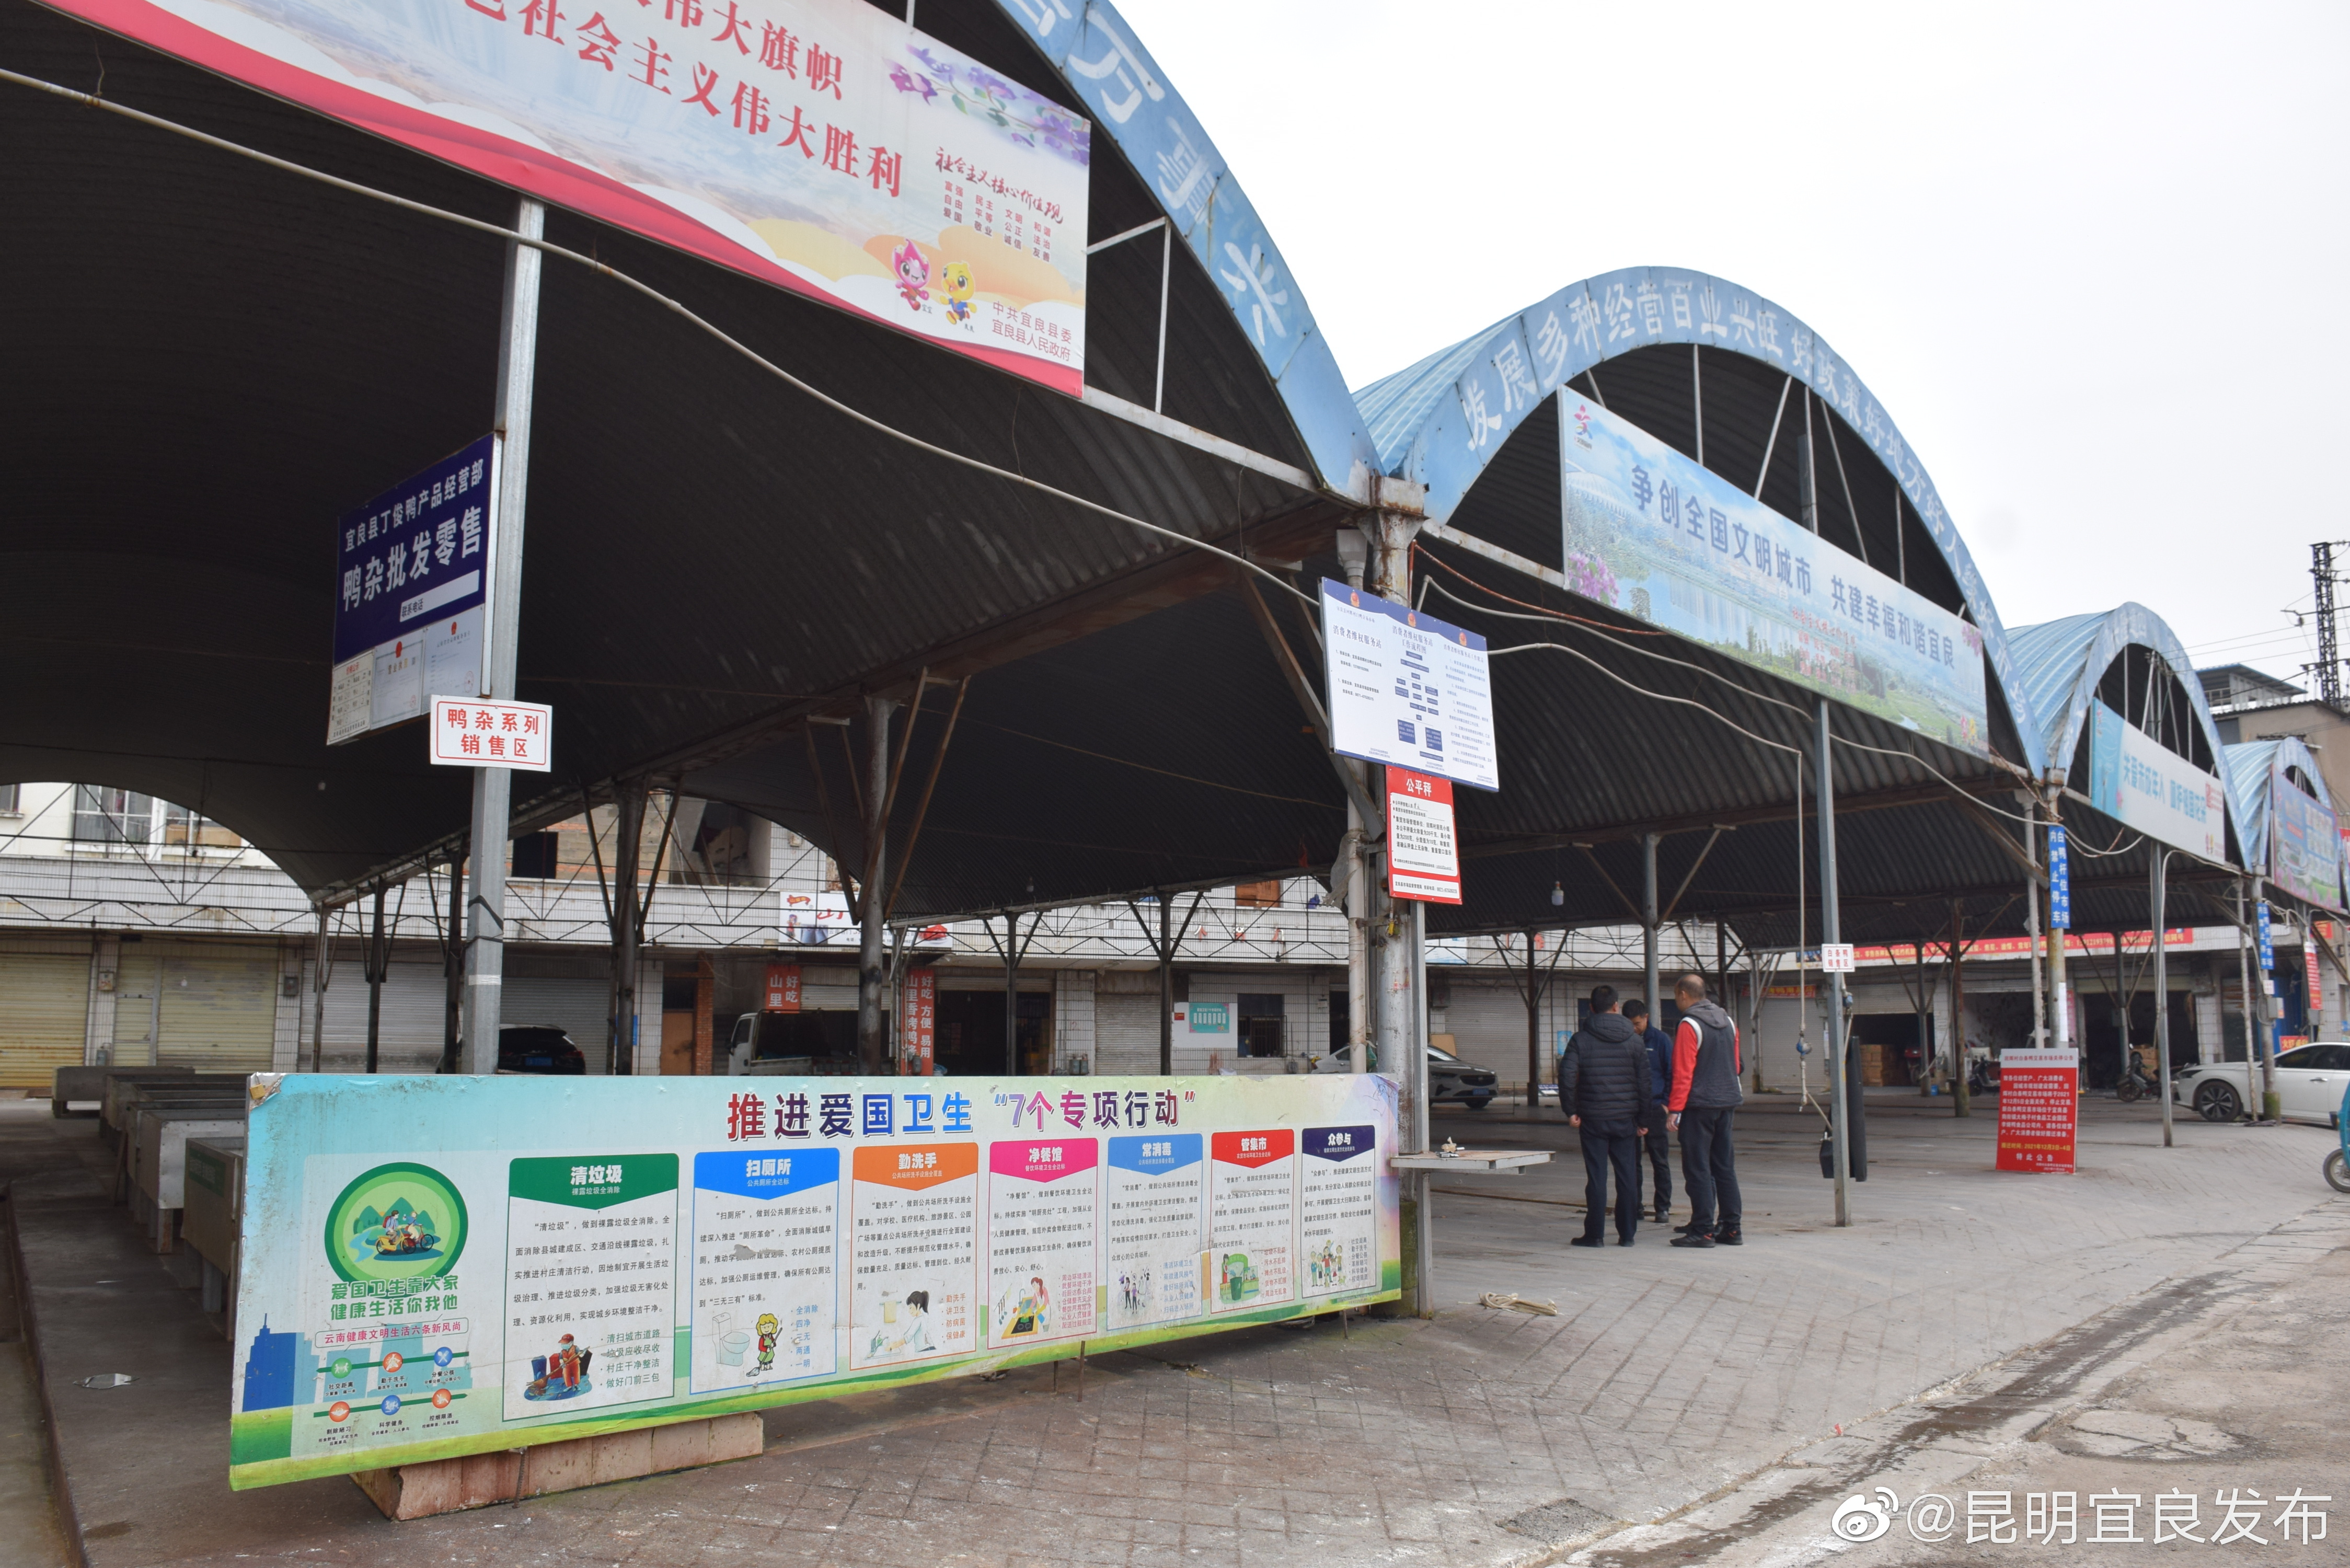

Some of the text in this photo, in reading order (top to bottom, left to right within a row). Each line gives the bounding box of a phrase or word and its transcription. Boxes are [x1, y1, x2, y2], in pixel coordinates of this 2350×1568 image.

[639, 0, 844, 100] 伟大旗帜
[944, 181, 1051, 237] 富强 民主 文明 和谐
[944, 195, 1050, 250] 自由 平等 公正 法治
[943, 208, 1050, 262] 爱国 敬业 诚信 友善
[993, 301, 1072, 344] 中共宜良县委
[992, 319, 1070, 361] 宜良县人民政府
[345, 458, 483, 552] 宜良县丁俊鸭产品经营部
[343, 505, 481, 612] 鸭杂批发零售
[1631, 464, 1811, 597] 争创全国文明城市
[1830, 575, 1955, 671] 共建幸福和谐宜良
[401, 597, 424, 618] 联系电话
[1333, 625, 1381, 649] 消费者维权服务站
[1392, 625, 1433, 647] 消费者维权服务站
[1402, 639, 1426, 654] 工作流程图
[448, 707, 539, 734] 鸭杂系列
[460, 734, 527, 758] 销售区
[1406, 778, 1432, 797] 公平秤
[769, 975, 782, 1013] 山里
[785, 975, 798, 1002] 好吃
[920, 976, 932, 1058] 好吃 方便 易用
[727, 1089, 1195, 1140] 推进爱国卫生 “7个专项行动”
[1241, 1137, 1266, 1151] 管集市
[1328, 1133, 1351, 1146] 众参与
[1029, 1147, 1063, 1163] 净餐馆
[1142, 1142, 1171, 1157] 常消毒
[746, 1158, 791, 1177] 扫厕所
[898, 1152, 937, 1170] 勤洗手
[570, 1165, 623, 1185] 清垃圾
[747, 1178, 789, 1187] 公共厕所全达标
[892, 1171, 942, 1179] 公共场所洗手设施全覆盖
[572, 1186, 620, 1196] 裸露垃圾全消除
[872, 1196, 972, 1209] “勤洗手”，做到公共场所洗手设施全
[717, 1205, 831, 1220] “扫厕所”，做到公共厕所全达标。持
[535, 1215, 670, 1231] “清垃圾”，做到裸露垃圾全消除。全
[700, 1225, 831, 1243] 续深入推进“厕所革命”，全面消除城镇旱
[515, 1237, 669, 1256] 面消除县城建成区、交通沿线裸露垃圾，扎
[699, 1245, 831, 1264] 厕，推动学所建设达标、农村公厕提质
[514, 1260, 669, 1279] 实推进村庄清洁行动，因地制宜开展生活垃
[857, 1256, 971, 1274] 保数量充足、质量达标、管理到位、经久耐
[994, 1264, 1044, 1275] 费放心、安心、舒心。
[699, 1266, 831, 1286] 达标，加强公厕运维管理，确保所有公厕达
[1062, 1272, 1092, 1282] 周边环境清洁
[331, 1274, 459, 1301] 爱国卫生靠大家
[514, 1281, 669, 1303] 圾治理、推进垃圾分类，加强垃圾无害化处
[946, 1293, 966, 1302] 勤洗手
[330, 1294, 458, 1321] 健康生活你我他
[513, 1304, 664, 1327] 理、资源化利用，实现城乡环境整洁干净。
[796, 1305, 819, 1315] 全消除
[946, 1306, 966, 1315] 讲卫生
[324, 1321, 461, 1344] 云南健康文明生活六条新风尚
[796, 1319, 810, 1328] 四净
[946, 1318, 966, 1328] 防病菌
[607, 1329, 660, 1343] 清扫城市道路
[946, 1331, 965, 1340] 保健康
[796, 1346, 810, 1355] 两通
[606, 1358, 660, 1373] 村庄干净整洁
[796, 1359, 810, 1368] 一明
[329, 1381, 353, 1390] 社交距离
[606, 1373, 660, 1389] 做好门前三包
[429, 1413, 453, 1421] 控烟限酒
